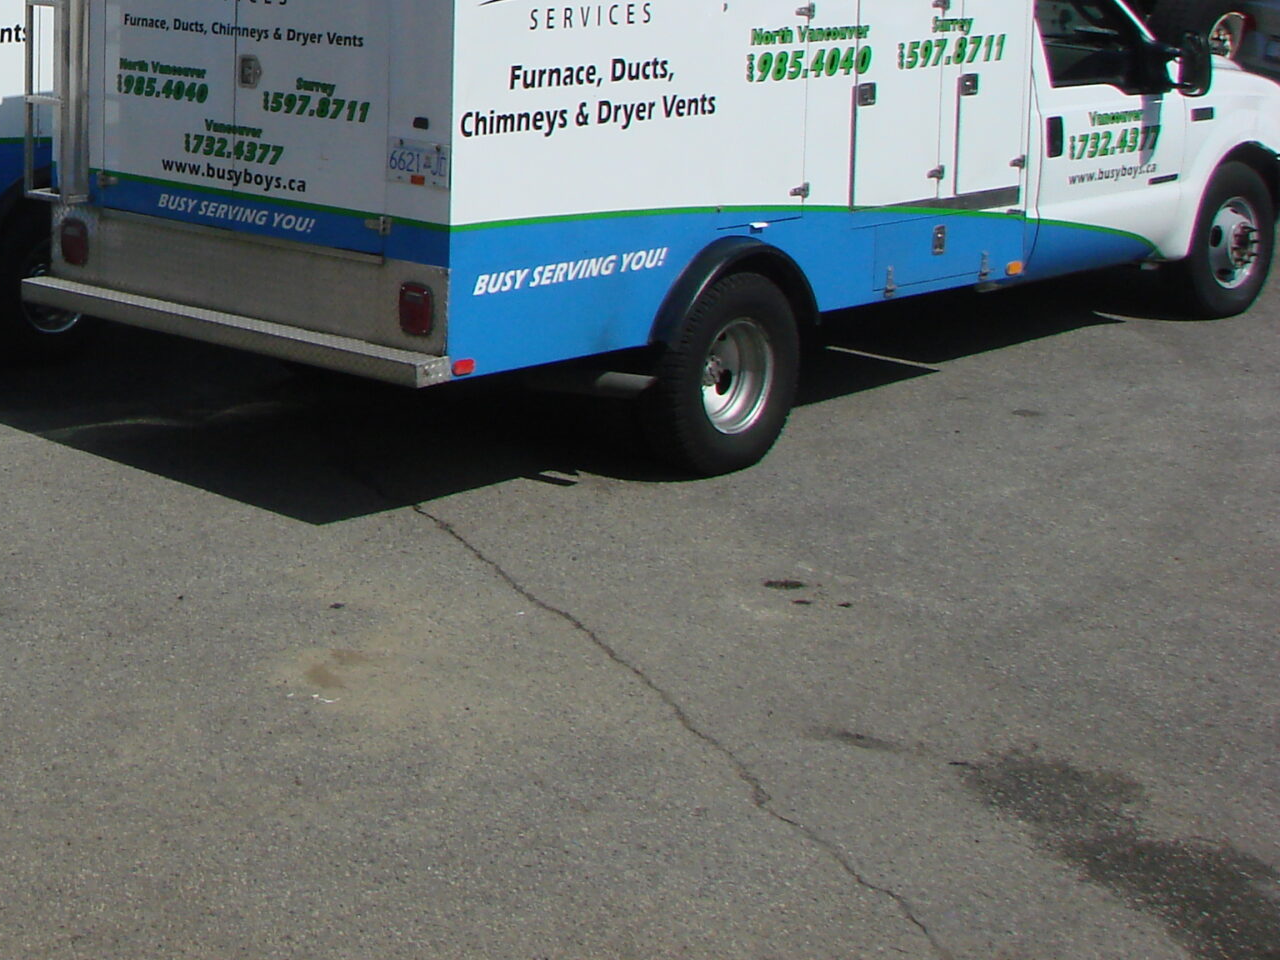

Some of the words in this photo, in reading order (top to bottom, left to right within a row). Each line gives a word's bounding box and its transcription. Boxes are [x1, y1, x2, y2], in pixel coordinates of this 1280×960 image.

[124, 13, 170, 32] Furnace,
[173, 18, 208, 36] Ducts,
[211, 22, 269, 42] Chimneys
[273, 27, 282, 40] &
[287, 28, 323, 46] Dryer
[327, 31, 364, 48] Vents
[529, 2, 652, 30] SERVICES
[932, 16, 974, 35] Surrey
[750, 27, 793, 45] North
[797, 25, 869, 43] Vancouver
[756, 45, 871, 82] 985.4040
[906, 34, 1006, 69] 597.8711
[120, 57, 148, 72] North
[151, 60, 207, 79] Vancouver
[509, 64, 603, 90] Furnace,
[611, 57, 674, 82] Ducts,
[124, 74, 209, 104] 985.4040
[296, 77, 336, 97] Surrey
[270, 92, 370, 123] 597.8711
[461, 108, 567, 137] Chimneys
[576, 102, 589, 126] &
[597, 100, 655, 129] Dryer
[662, 94, 716, 118] Vents
[205, 118, 263, 139] Vancouver
[1076, 125, 1161, 160] 732.4377
[192, 134, 284, 165] 732.4377
[389, 150, 420, 173] 6621
[162, 159, 306, 192] www.busyboys.ca
[1068, 163, 1156, 185] www.busyboys.ca
[157, 194, 196, 214] BUSY
[198, 201, 268, 225] SERVING
[271, 213, 316, 233] YOU!
[473, 269, 529, 296] BUSY
[529, 255, 617, 288] SERVING
[620, 247, 668, 273] YOU!
